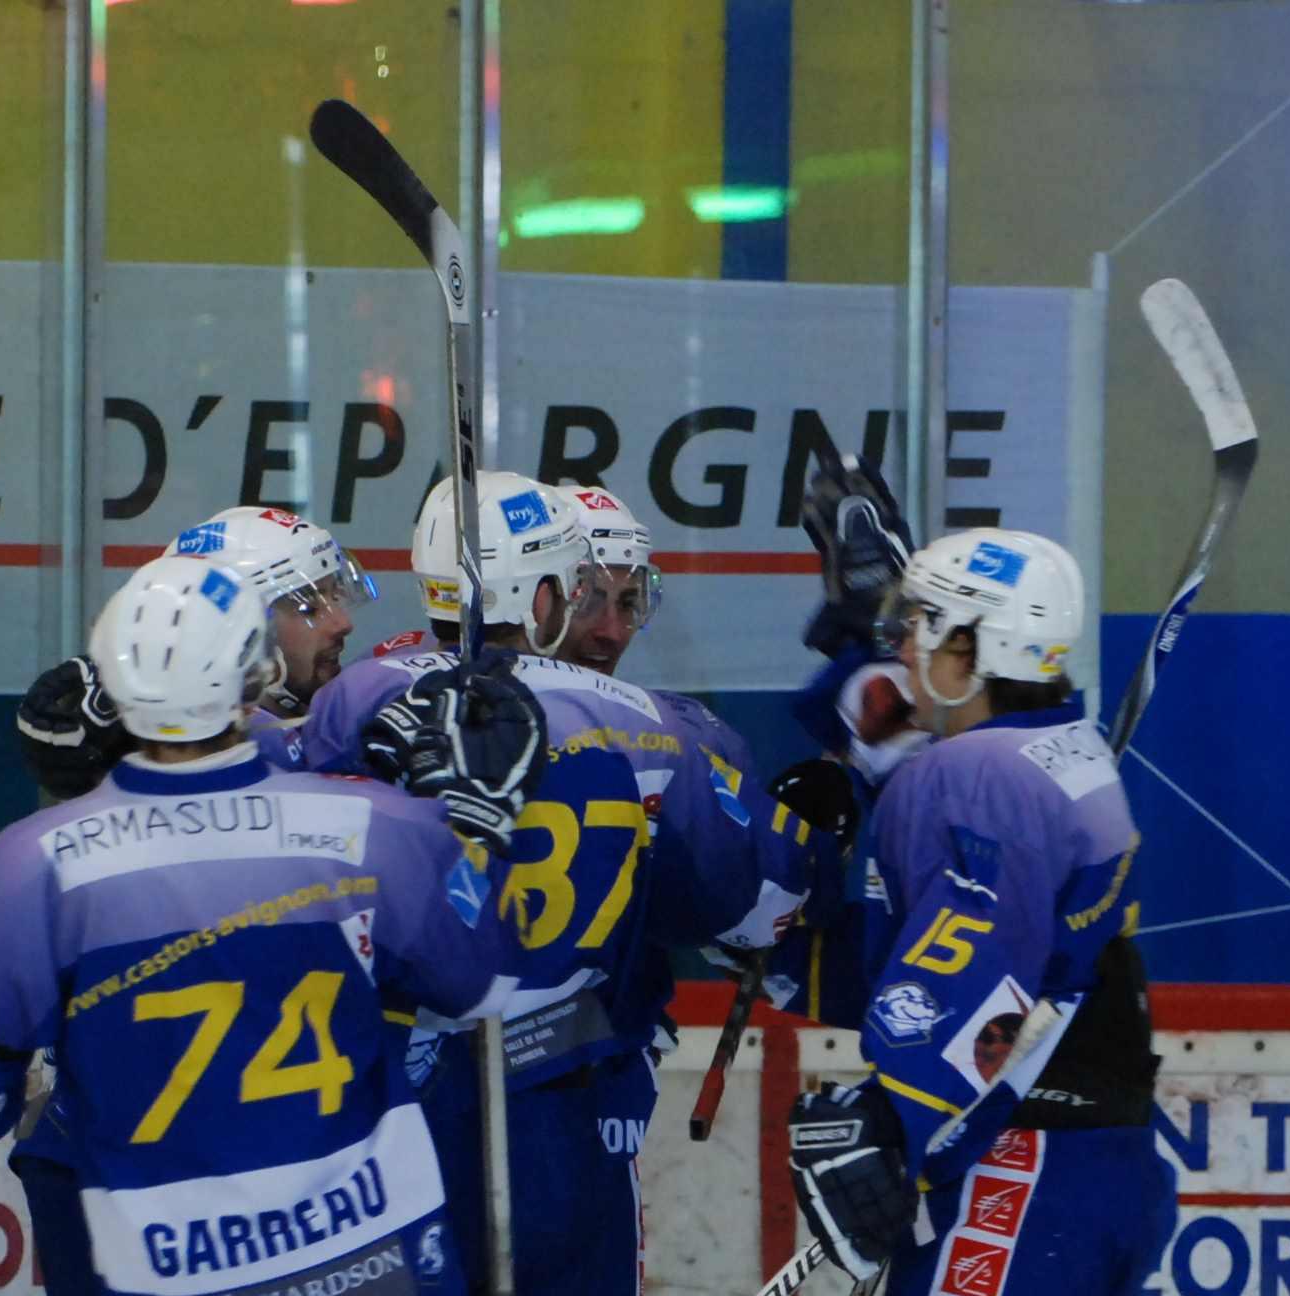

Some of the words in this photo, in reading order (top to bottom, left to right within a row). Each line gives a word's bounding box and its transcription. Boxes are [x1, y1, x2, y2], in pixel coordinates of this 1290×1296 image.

[103, 394, 1006, 529] D'EPRGNE
[53, 795, 275, 863] ARMASUD
[902, 907, 994, 975] 15
[131, 970, 354, 1144] 74
[142, 1156, 390, 1278] GARREAU
